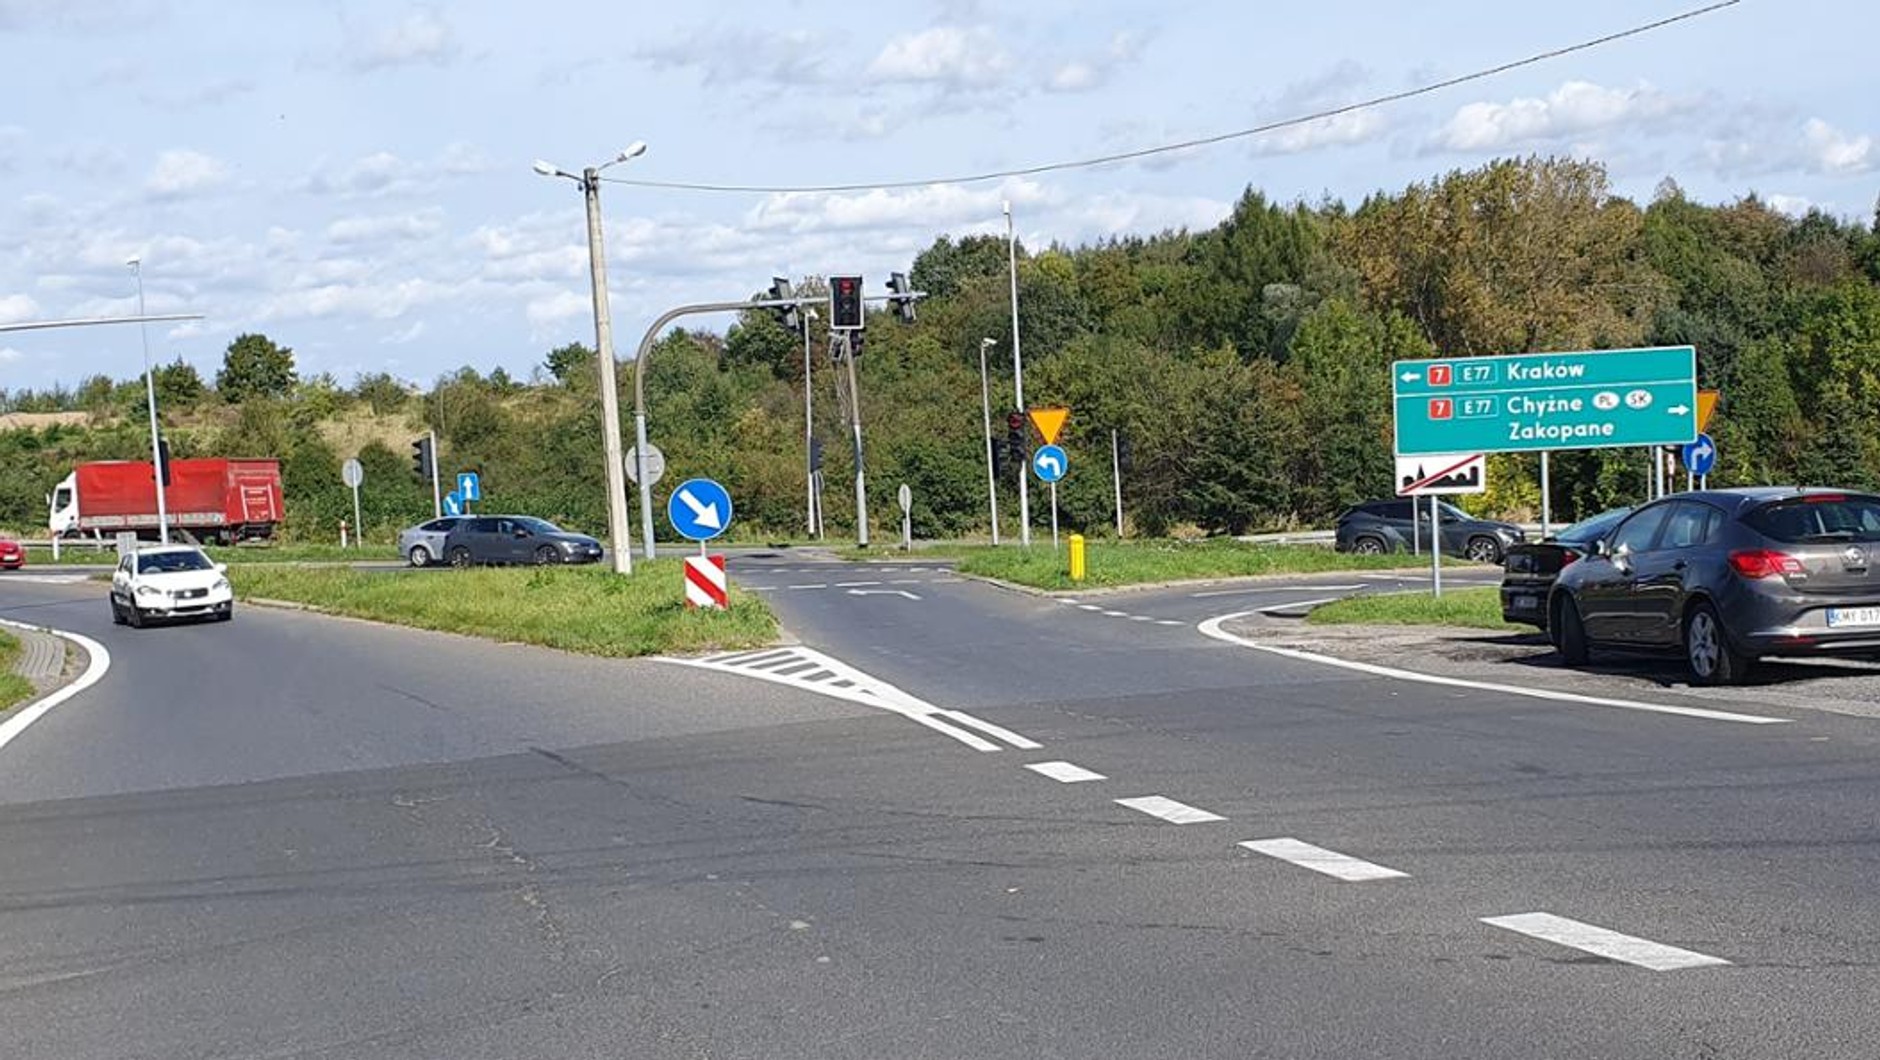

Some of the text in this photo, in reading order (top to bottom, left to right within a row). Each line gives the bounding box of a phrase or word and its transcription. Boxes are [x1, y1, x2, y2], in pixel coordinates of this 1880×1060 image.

[1432, 368, 1444, 383] 7
[1507, 361, 1584, 380] Kraków
[1434, 401, 1446, 416] 7
[1507, 394, 1583, 417] Chyżne
[1598, 394, 1613, 406] PL
[1630, 392, 1648, 405] SK
[1509, 422, 1614, 443] Zakopane
